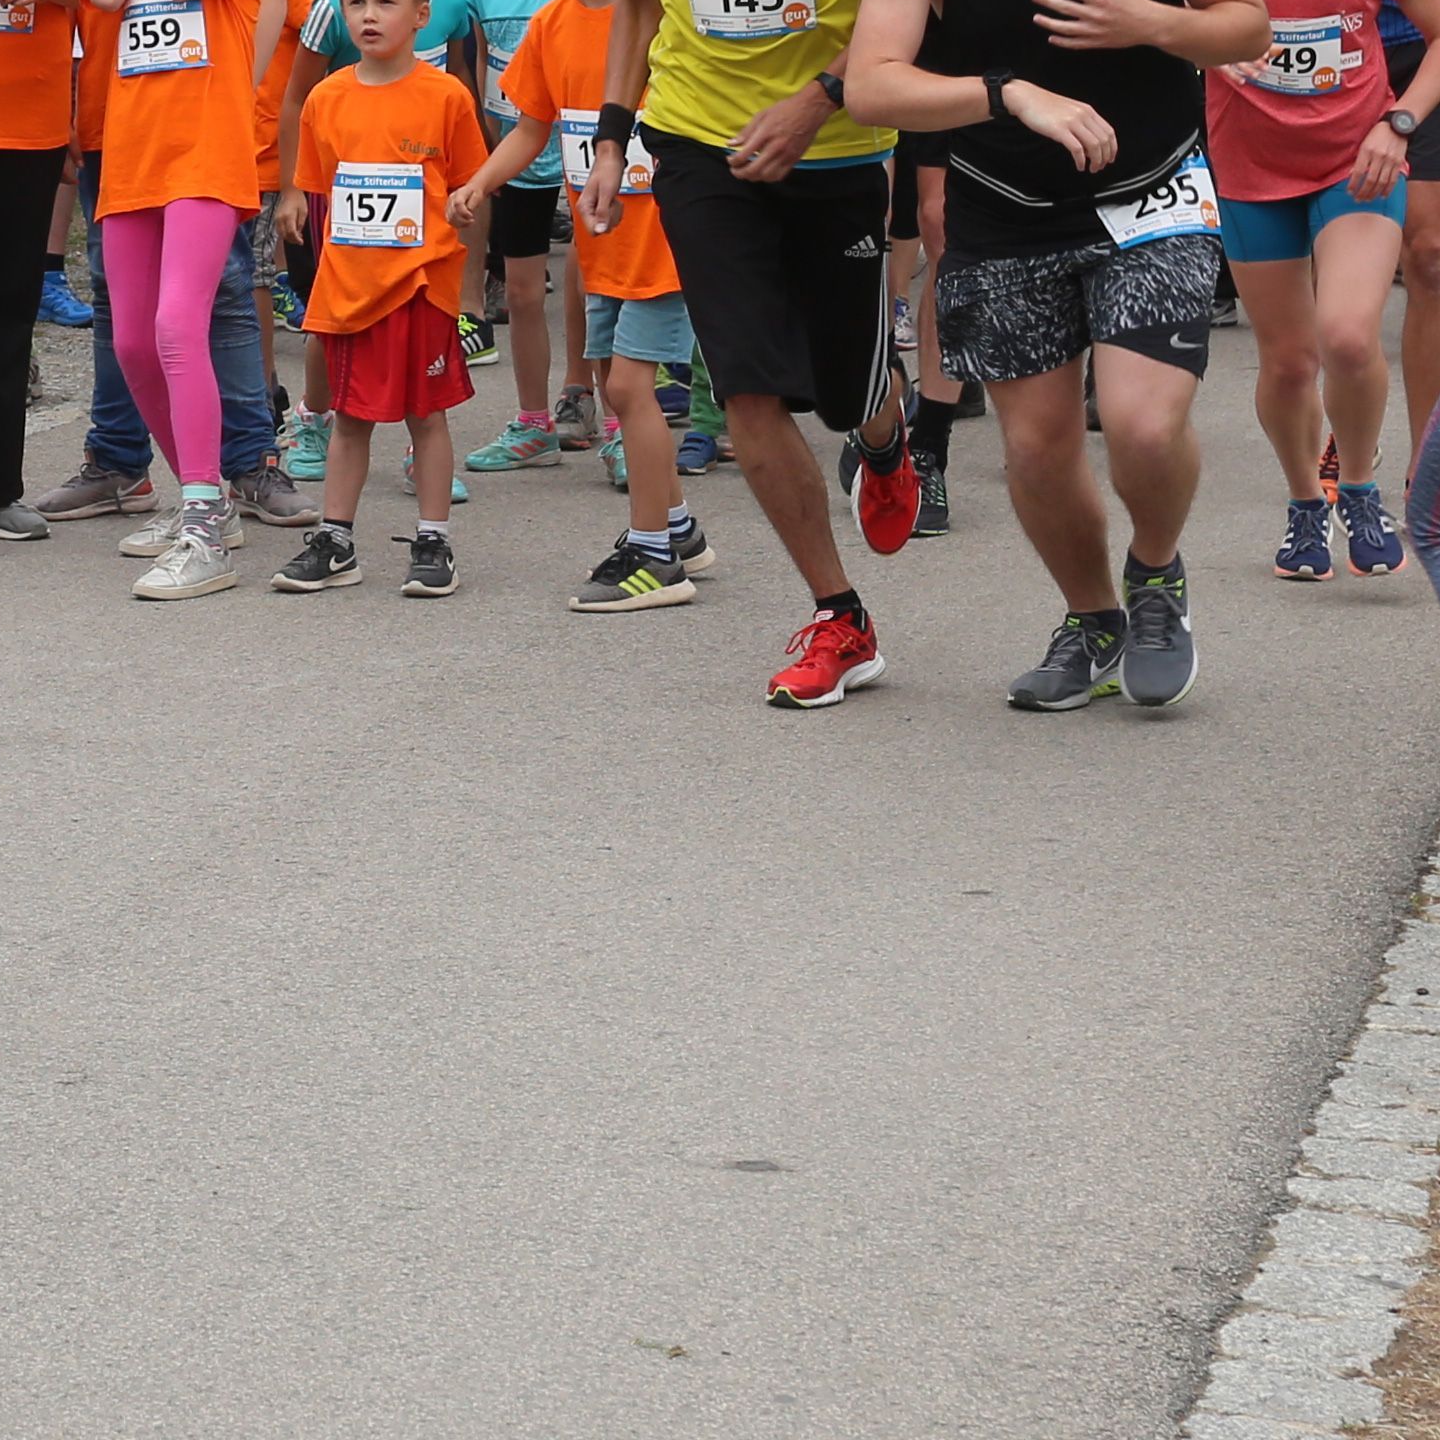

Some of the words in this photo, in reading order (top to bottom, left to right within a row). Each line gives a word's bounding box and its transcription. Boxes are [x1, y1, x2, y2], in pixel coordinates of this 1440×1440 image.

[144, 2, 187, 14] Stifterlauf
[10, 12, 28, 23] gut
[784, 8, 808, 24] gut
[129, 17, 181, 51] 559
[1280, 30, 1326, 42] Stifterlauf
[181, 46, 201, 58] gut
[1313, 72, 1335, 85] gut
[363, 176, 408, 187] Stifterlauf
[629, 172, 649, 184] gut
[1135, 173, 1200, 220] 295
[345, 192, 399, 223] 157
[397, 225, 416, 237] gut
[844, 248, 879, 258] adidas
